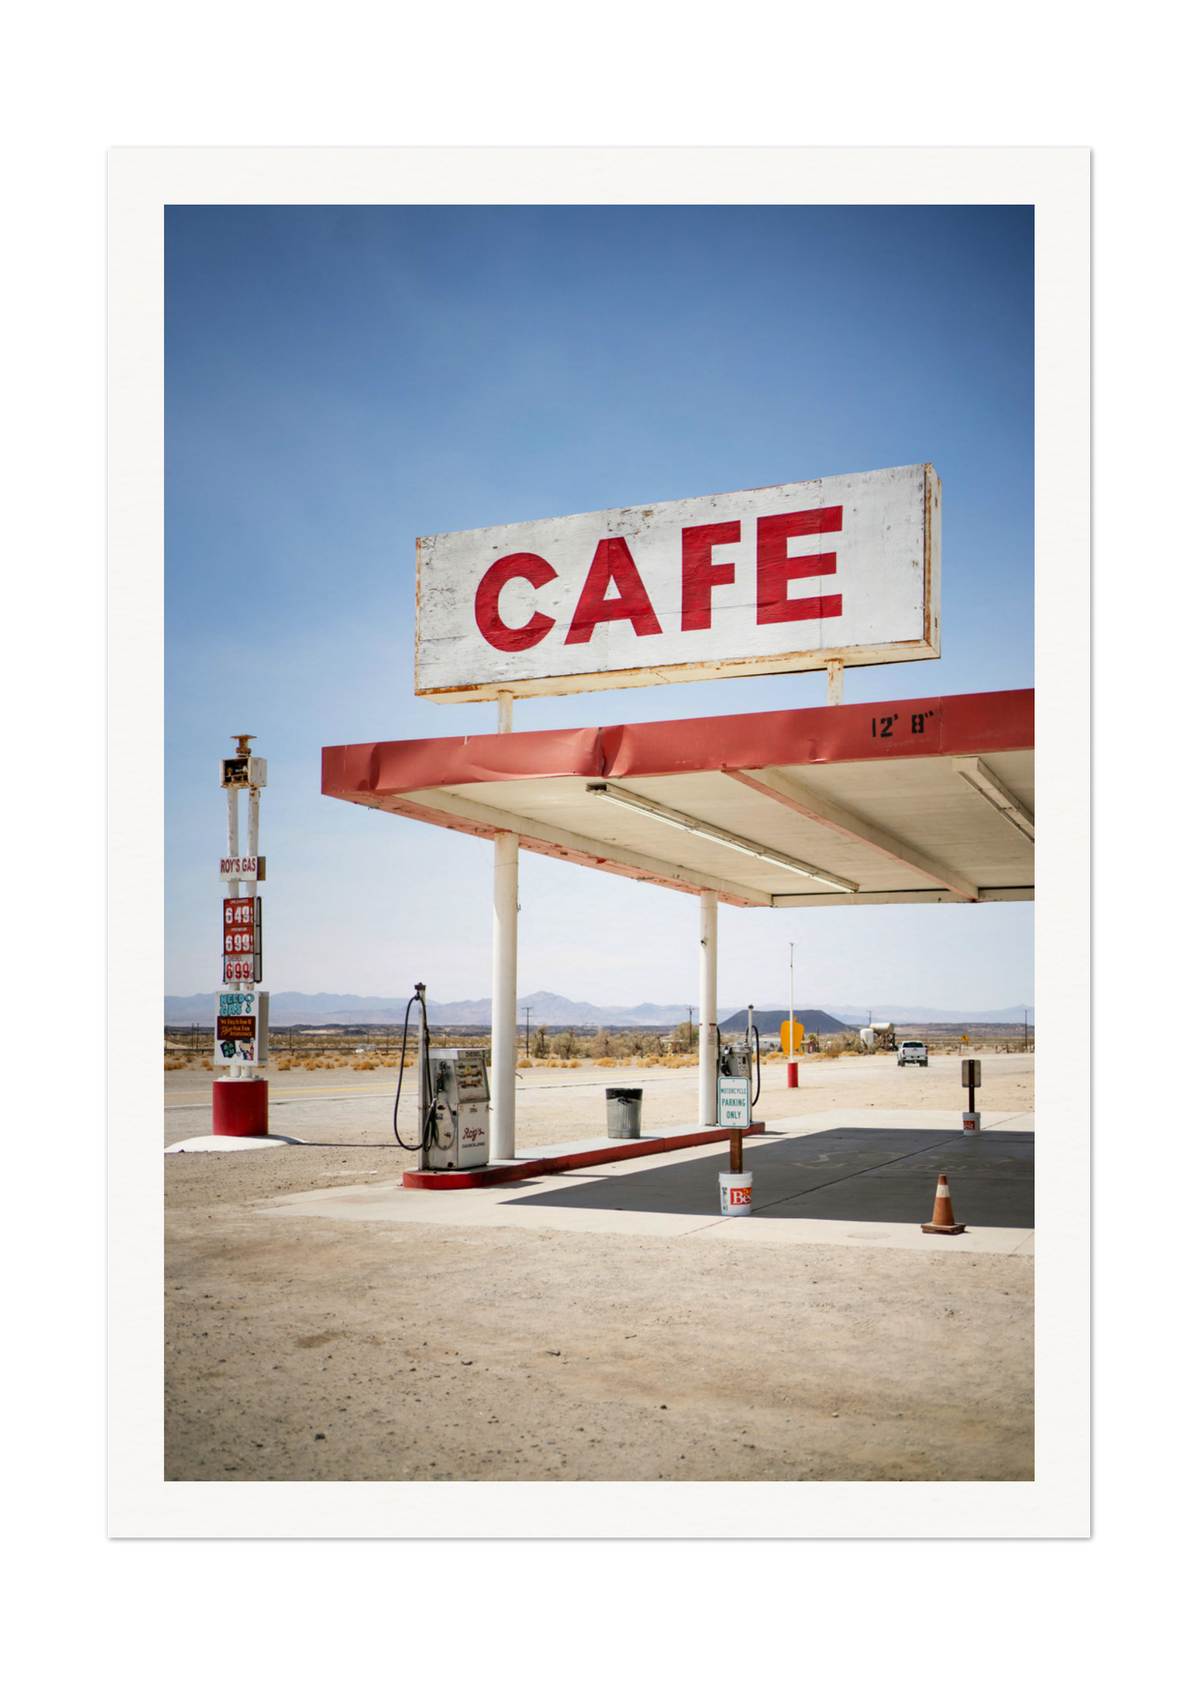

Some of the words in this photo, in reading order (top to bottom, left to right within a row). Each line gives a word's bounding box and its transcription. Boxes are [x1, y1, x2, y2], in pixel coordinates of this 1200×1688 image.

[474, 505, 843, 653] CAFE
[220, 858, 241, 874] ROY'S
[241, 857, 256, 872] GAS
[219, 993, 245, 1007] NEED
[720, 1087, 747, 1095] MOTORCYCLE
[721, 1098, 746, 1107] PARKING
[726, 1110, 741, 1119] ONLY
[462, 1127, 485, 1142] Roy's
[461, 1141, 486, 1149] GASOLINE
